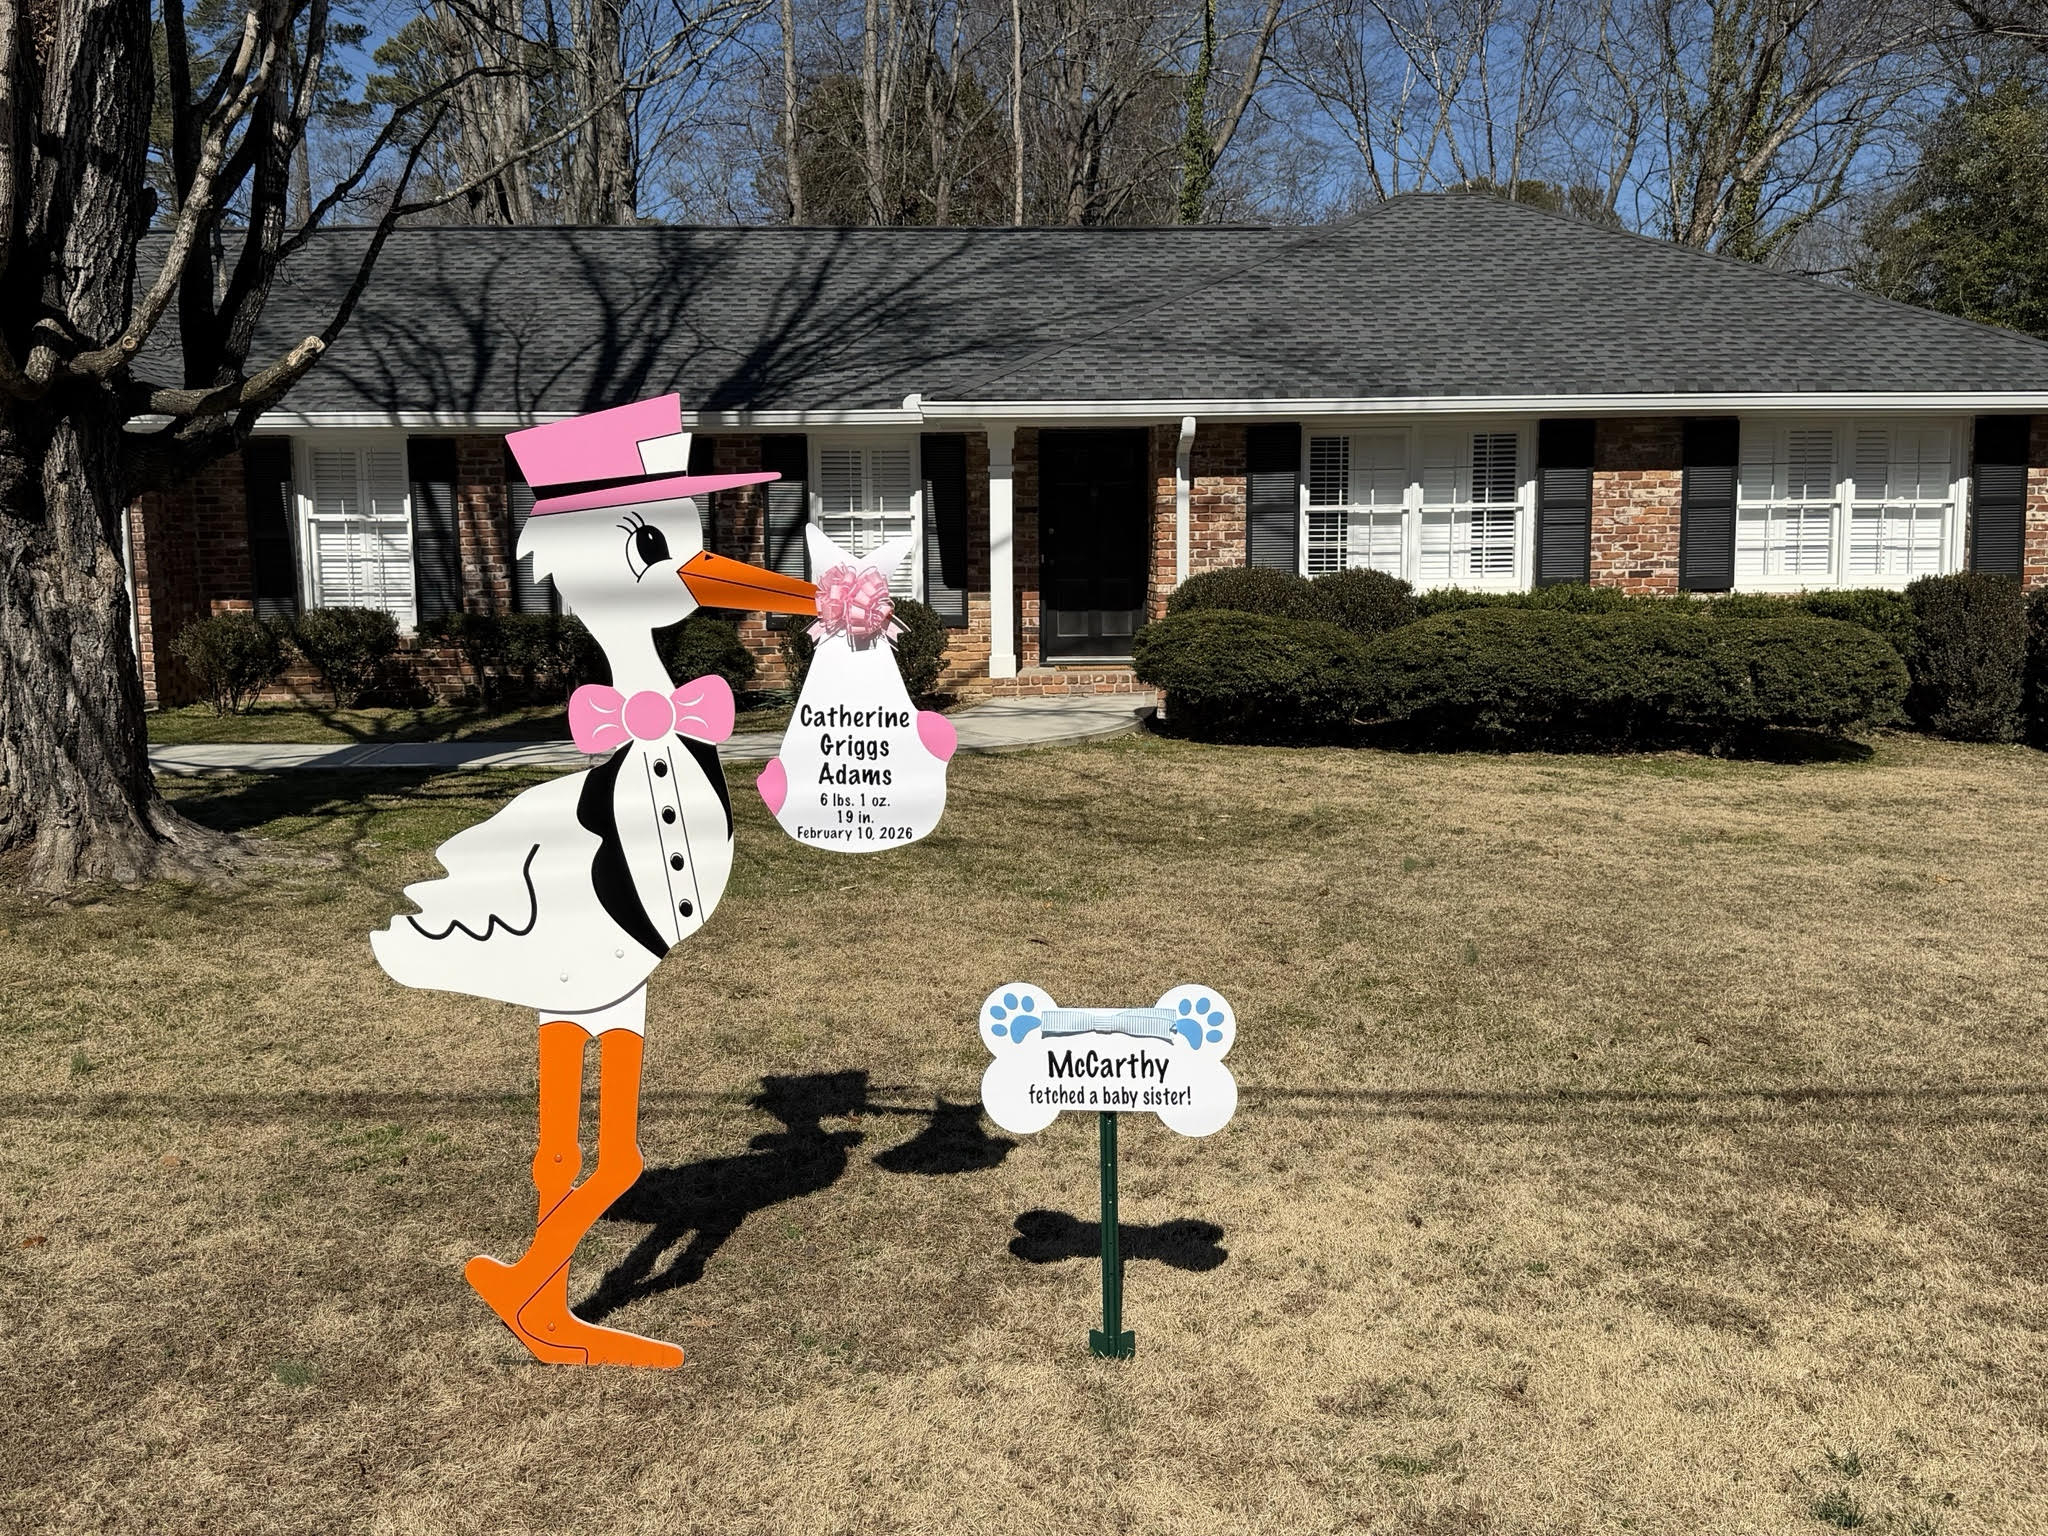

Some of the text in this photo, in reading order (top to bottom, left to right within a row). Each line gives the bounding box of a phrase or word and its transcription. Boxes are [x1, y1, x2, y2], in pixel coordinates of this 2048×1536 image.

[800, 703, 910, 728] Catherine
[820, 733, 890, 761] Griggs
[818, 761, 892, 786] Adams
[820, 792, 891, 808] 6 lbs. 1 oz.
[837, 809, 874, 824] 19 in.
[797, 825, 913, 841] February 10, 2026
[1047, 1049, 1170, 1084] McCarthy
[1028, 1083, 1191, 1109] fetched a baby sister!
